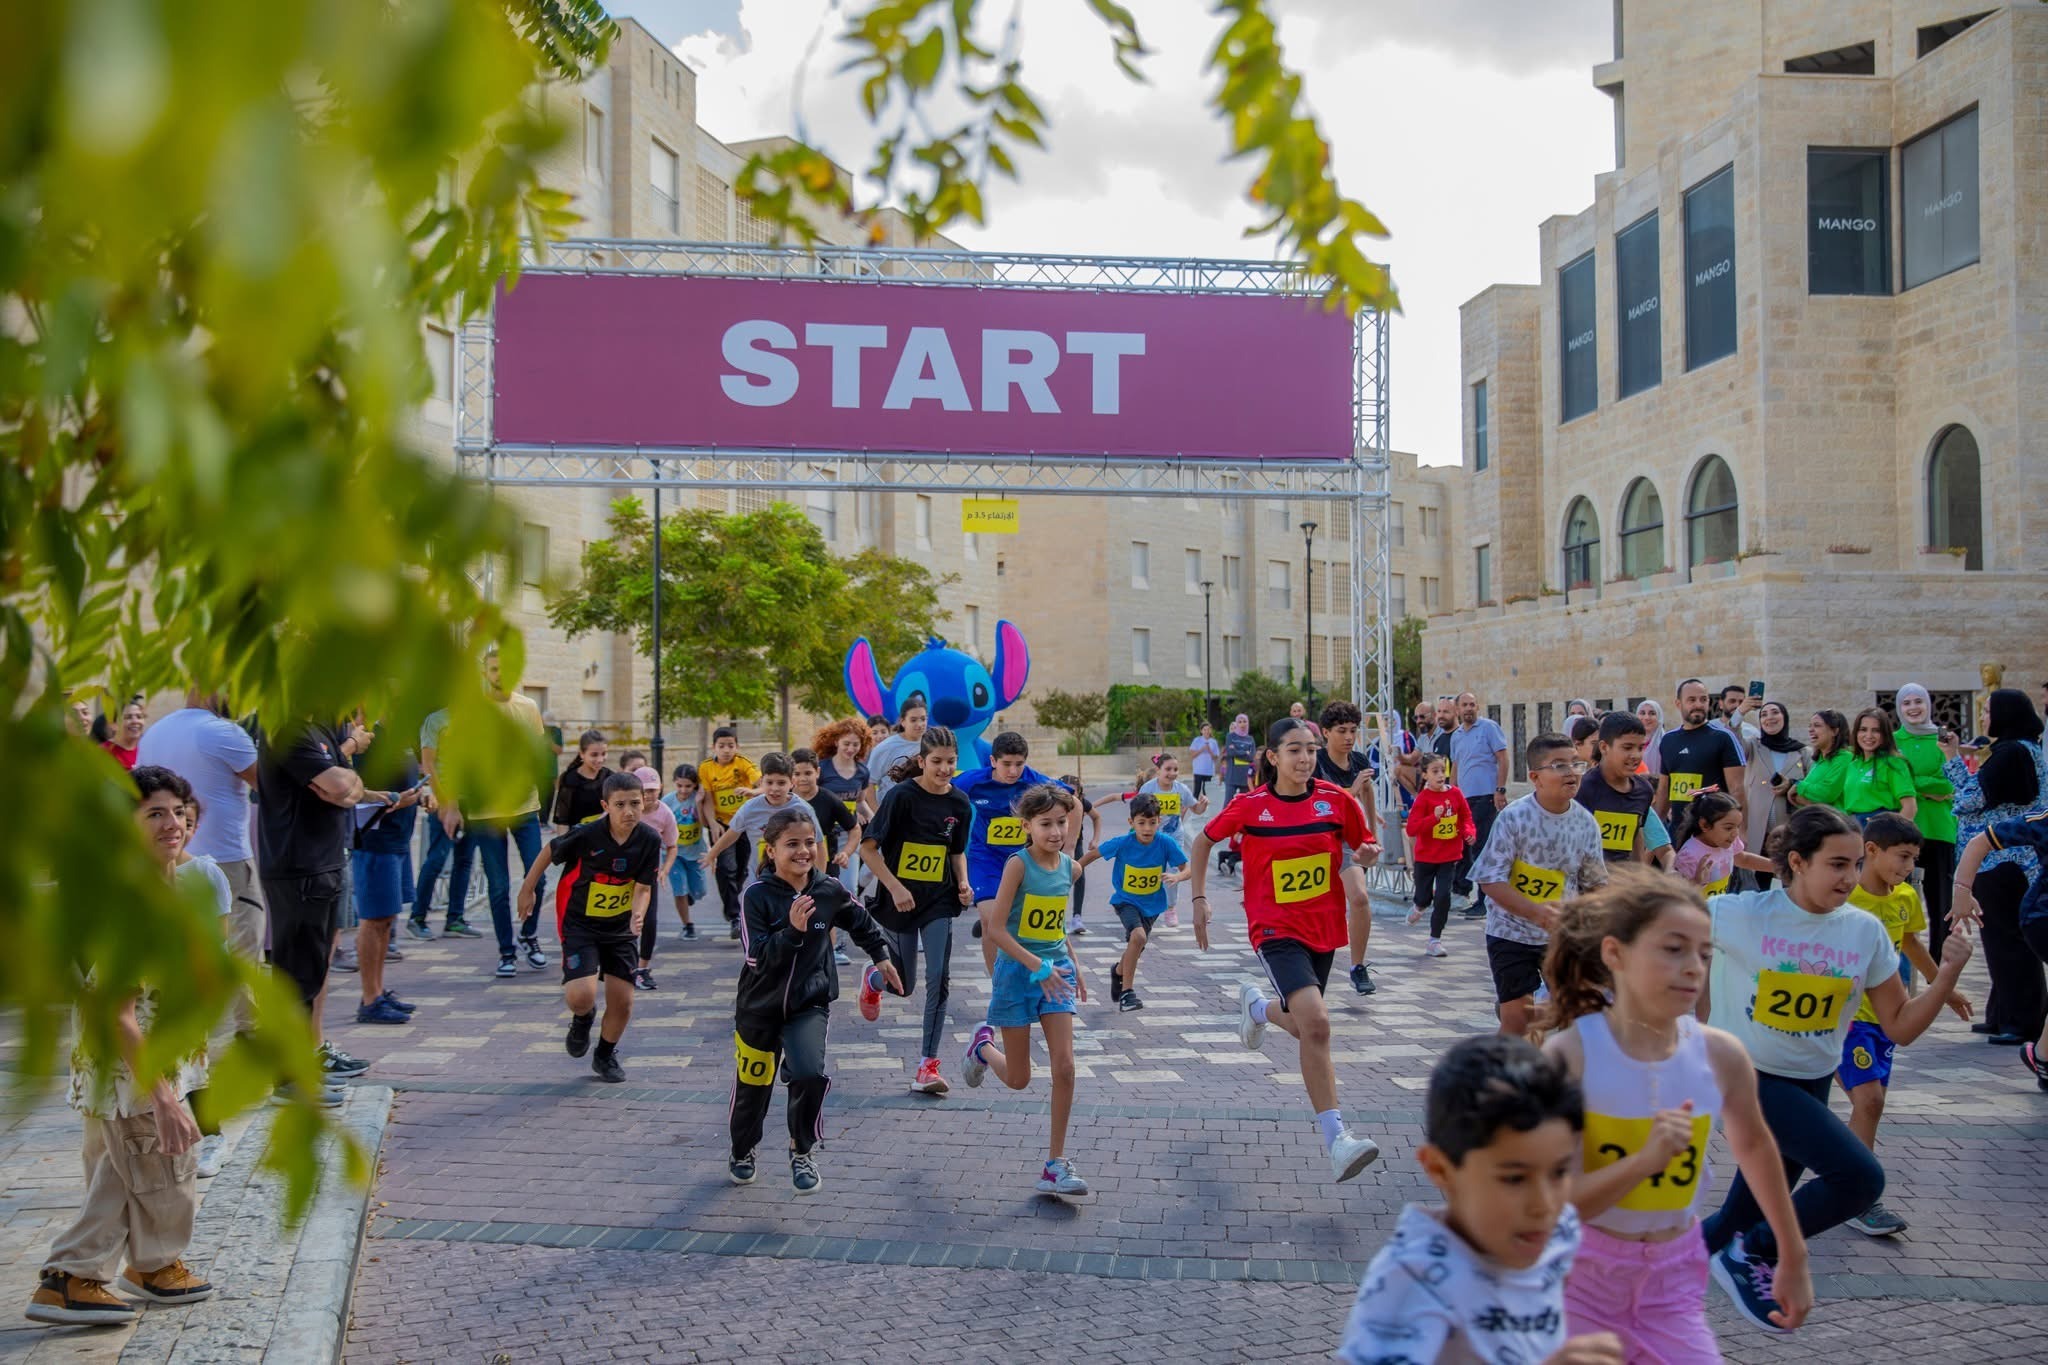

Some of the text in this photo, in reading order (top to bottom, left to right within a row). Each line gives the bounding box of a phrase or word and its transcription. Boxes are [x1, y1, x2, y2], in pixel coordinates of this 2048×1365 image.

[1924, 191, 1963, 217] MANGO
[1818, 217, 1877, 231] MANGO
[1695, 259, 1731, 287] MANGO
[1628, 296, 1658, 321] MANGO
[1568, 330, 1594, 352] MANGO
[719, 319, 1146, 415] START
[1159, 800, 1177, 810] 212
[993, 825, 1023, 839] 227
[1438, 823, 1456, 835] 23
[1601, 823, 1627, 841] 211
[905, 853, 942, 873] 207
[1127, 874, 1158, 888] 239
[1280, 866, 1326, 893] 220
[1515, 874, 1558, 898] 237
[593, 891, 630, 910] 226
[1028, 908, 1065, 930] 028
[1761, 935, 1860, 968] KEEP PALM
[1768, 989, 1835, 1019] 201
[737, 1047, 766, 1077] 10
